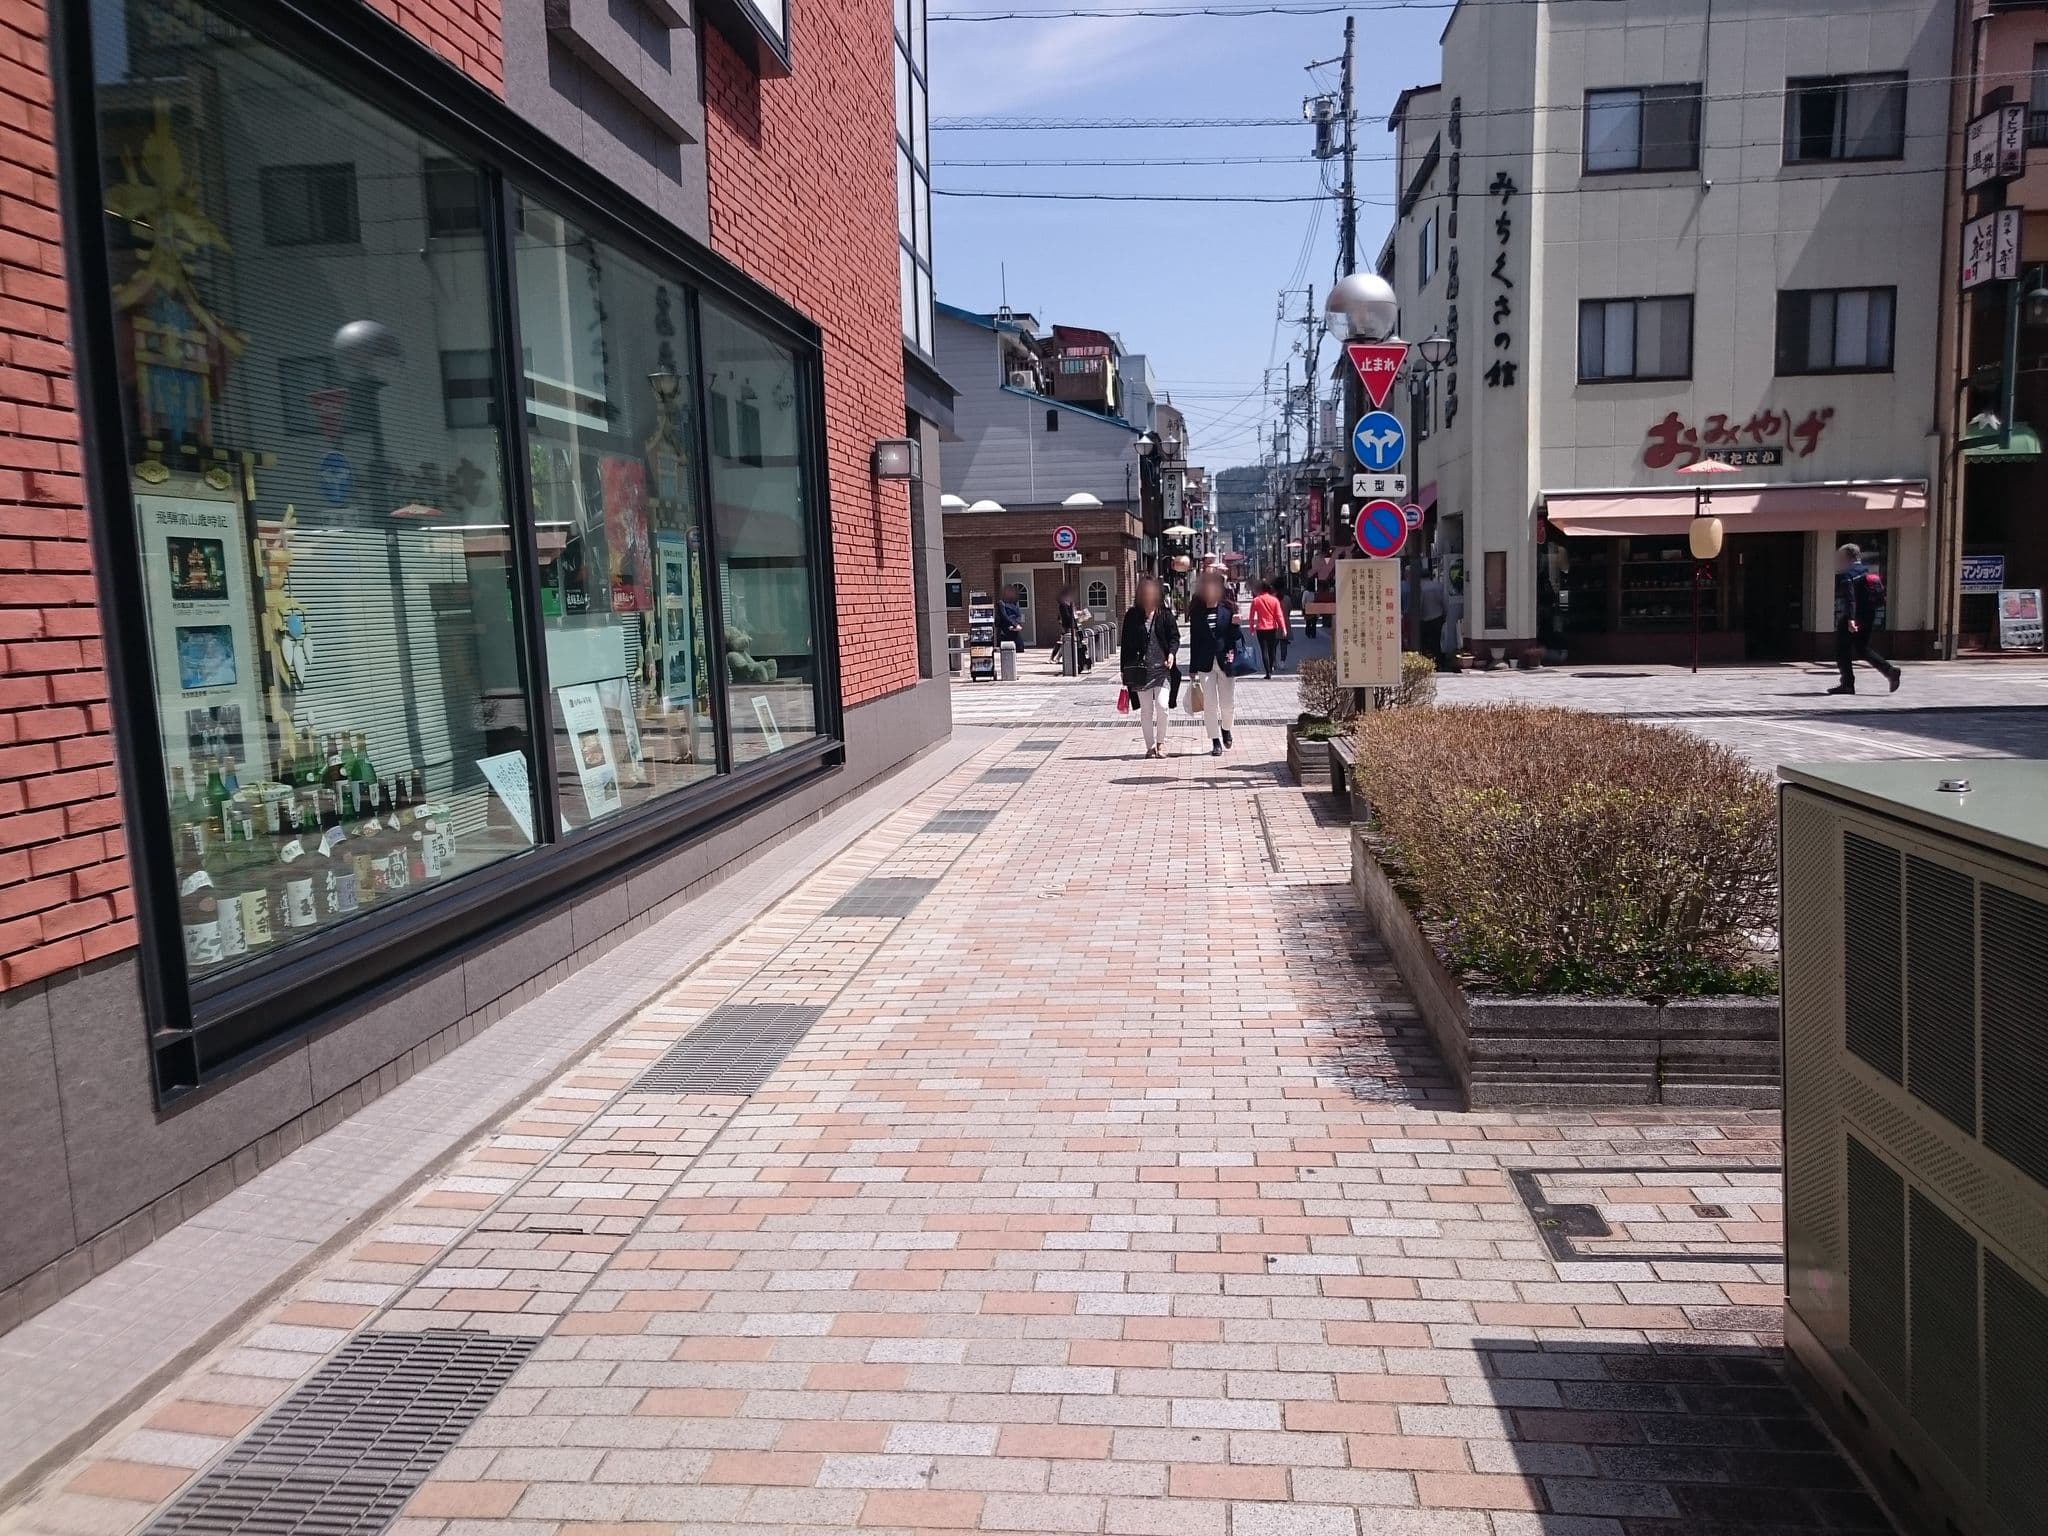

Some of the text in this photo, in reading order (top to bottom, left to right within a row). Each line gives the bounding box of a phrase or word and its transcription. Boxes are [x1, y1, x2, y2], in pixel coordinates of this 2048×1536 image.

[1360, 357, 1396, 372] 止まれ
[1643, 407, 1834, 470] おみやげ
[1355, 479, 1405, 492] 大型等
